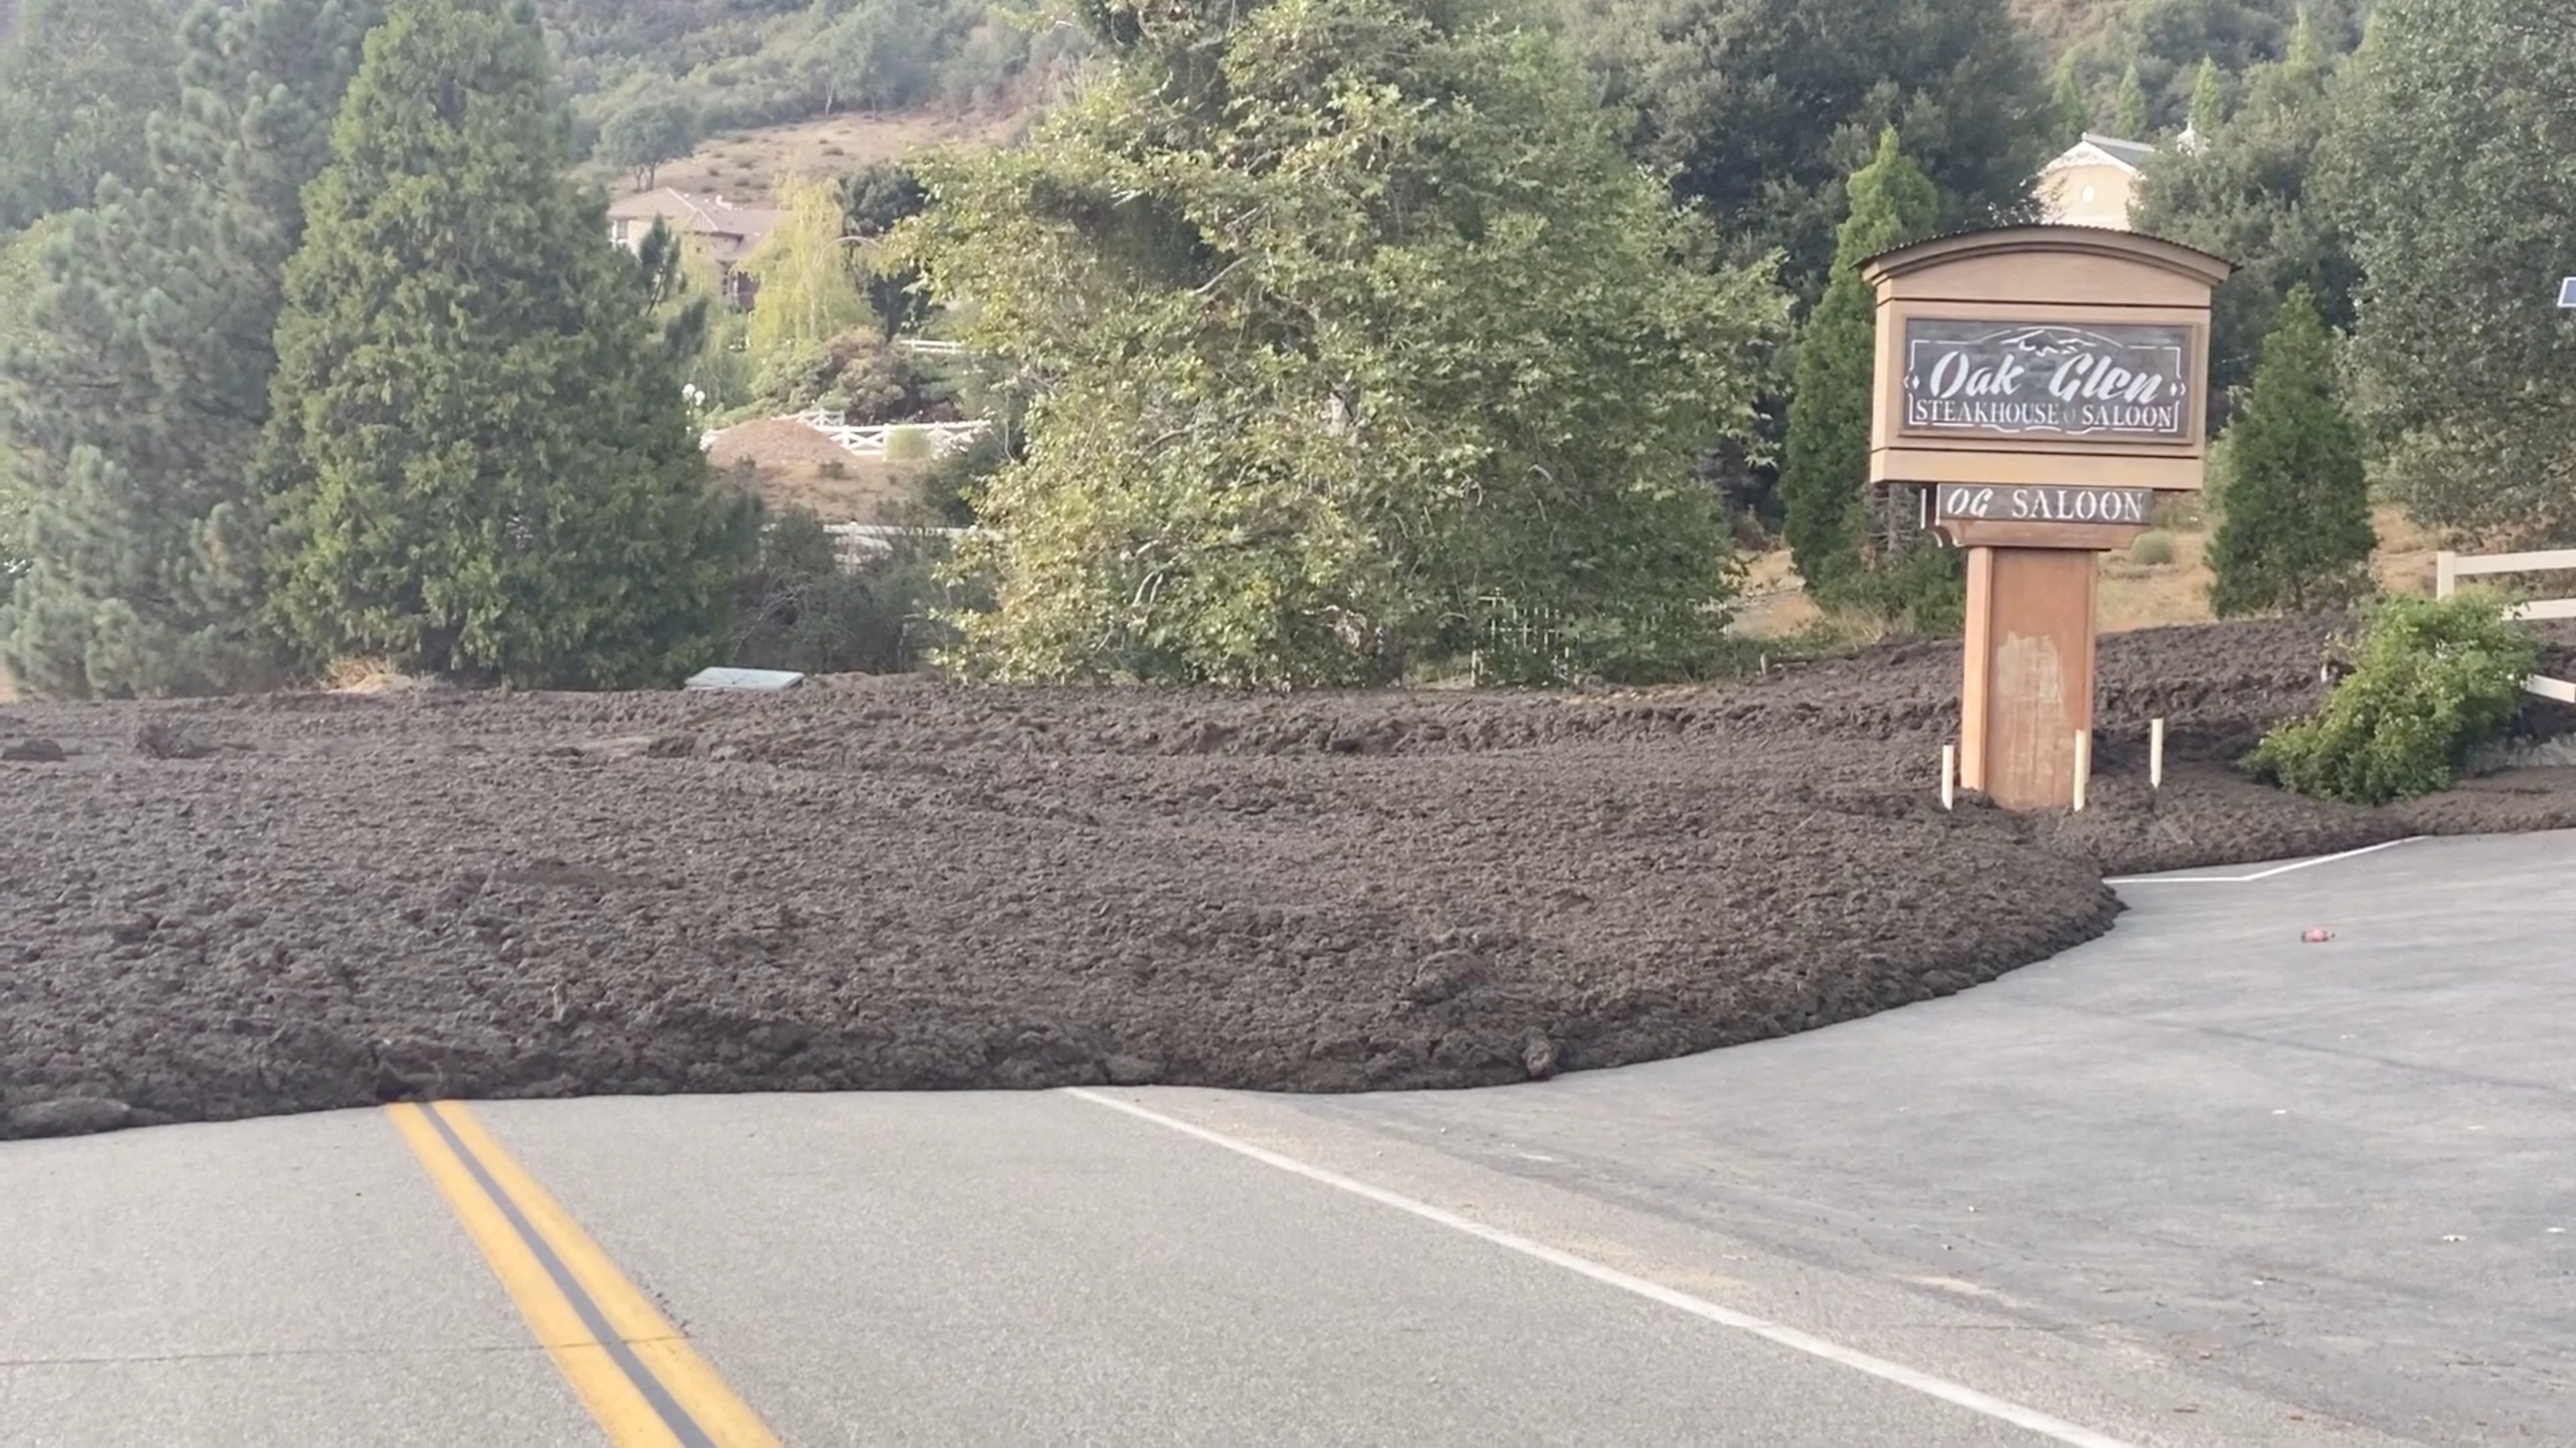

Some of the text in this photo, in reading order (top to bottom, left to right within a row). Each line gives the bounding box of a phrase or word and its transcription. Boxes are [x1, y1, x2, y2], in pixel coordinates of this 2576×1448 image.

[1929, 350, 2163, 404] Oak Glen
[1915, 398, 2059, 425] STEAKHOUSE
[2082, 404, 2171, 427] SALOON
[1947, 487, 2143, 521] OG SALOON
